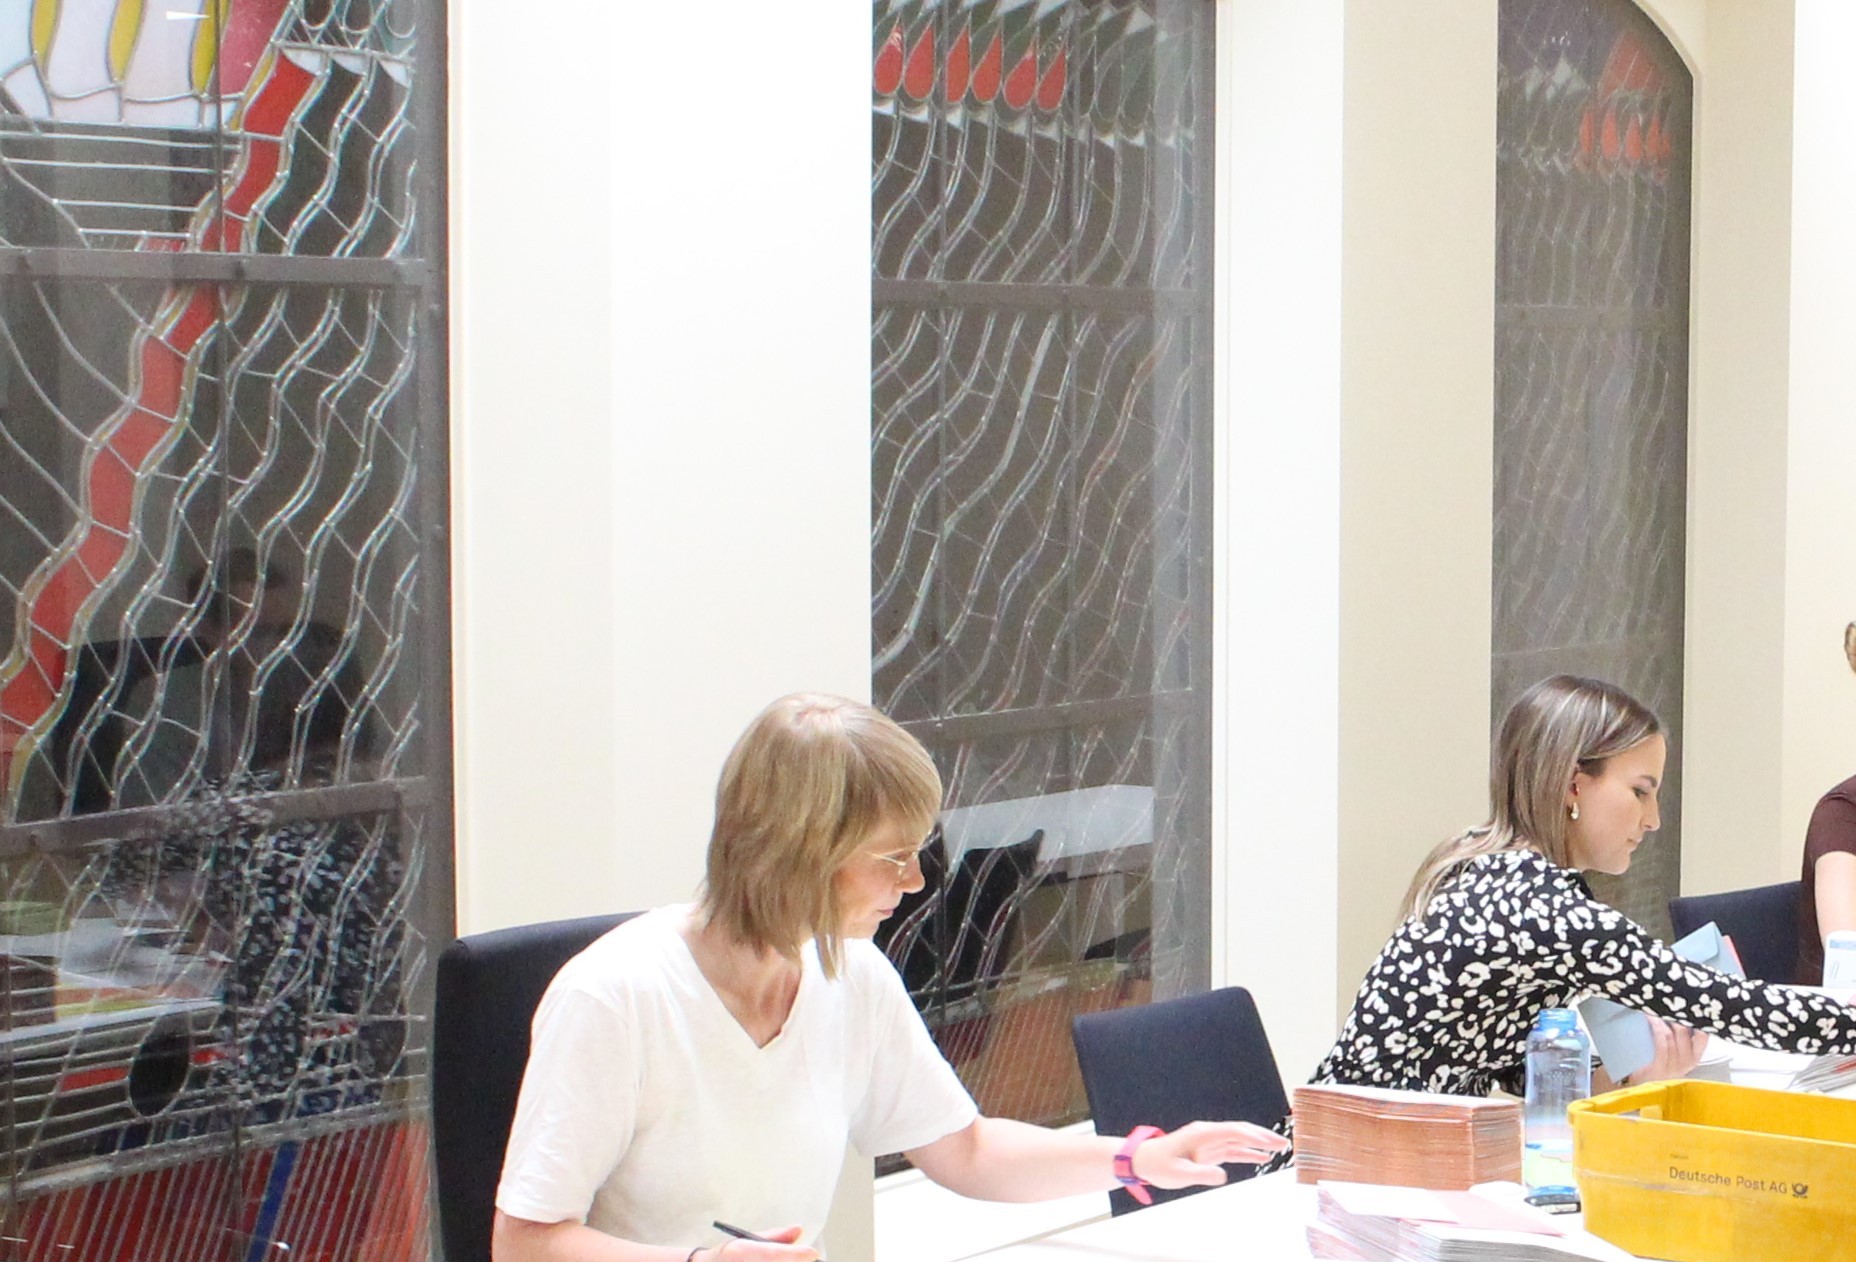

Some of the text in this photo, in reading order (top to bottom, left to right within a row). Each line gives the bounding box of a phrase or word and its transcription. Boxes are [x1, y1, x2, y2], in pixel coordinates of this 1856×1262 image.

[1669, 1166, 1788, 1194] Deutsche Post AG
